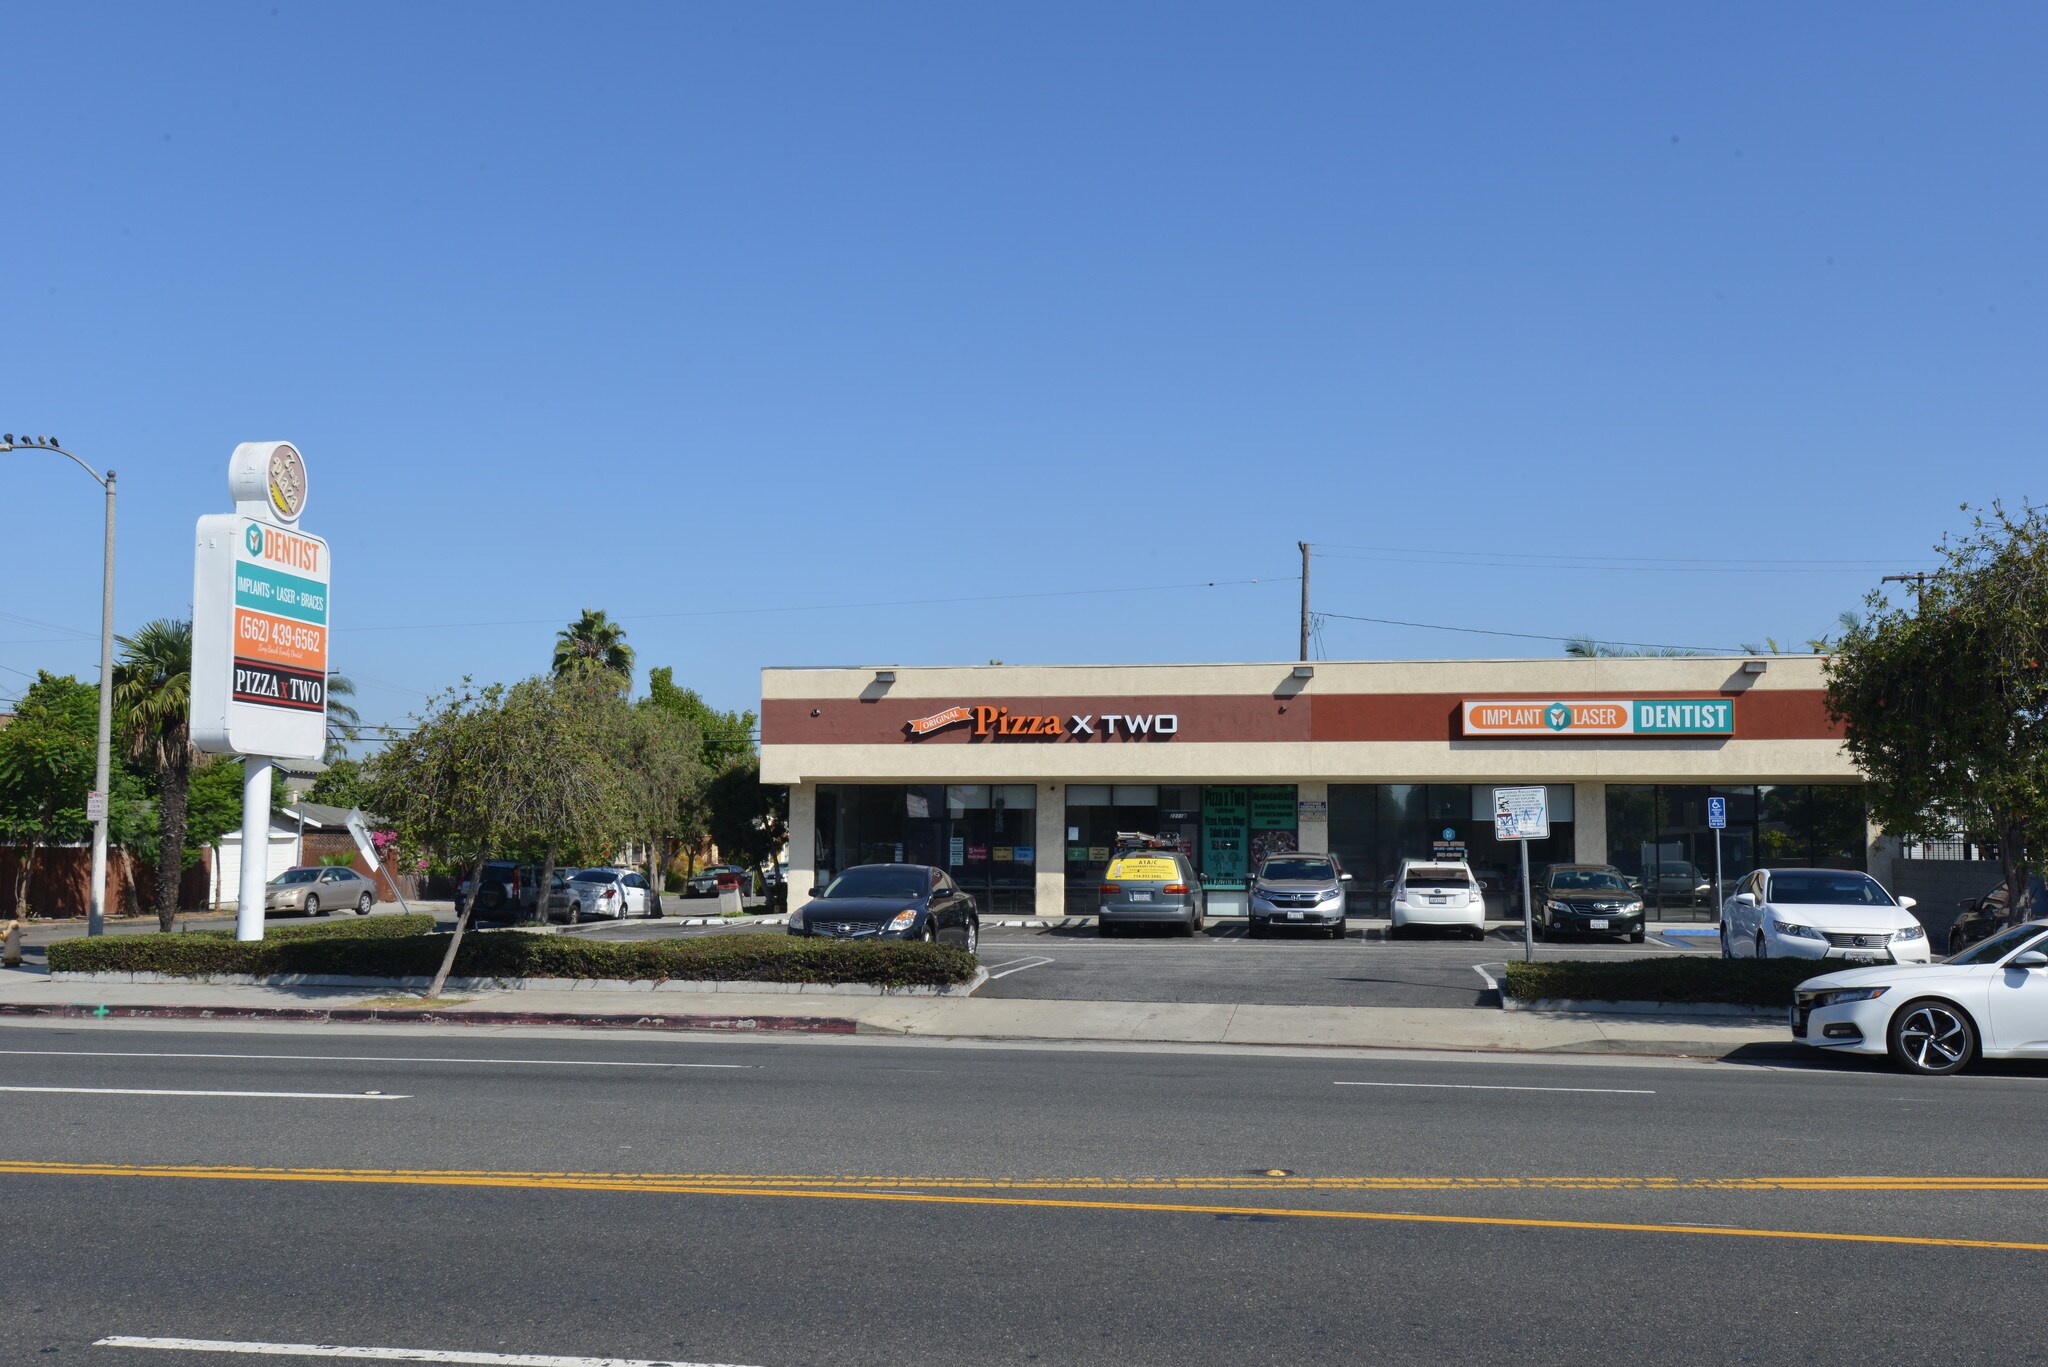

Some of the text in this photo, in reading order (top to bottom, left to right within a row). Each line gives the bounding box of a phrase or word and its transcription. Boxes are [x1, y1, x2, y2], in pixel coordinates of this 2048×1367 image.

[265, 529, 319, 572] DENTIST
[237, 576, 324, 611] IMPLANTS LASER BRACES
[240, 615, 269, 643] (562)
[235, 669, 279, 697] PIZZA
[290, 678, 321, 704] TWO
[922, 709, 959, 730] ORIGINAL
[974, 705, 1064, 735] Pizza
[1101, 714, 1178, 734] TWO
[1482, 705, 1727, 728] IMPLANT LASER DENTIST
[1205, 789, 1223, 806] Pizza
[1230, 788, 1245, 806] Two
